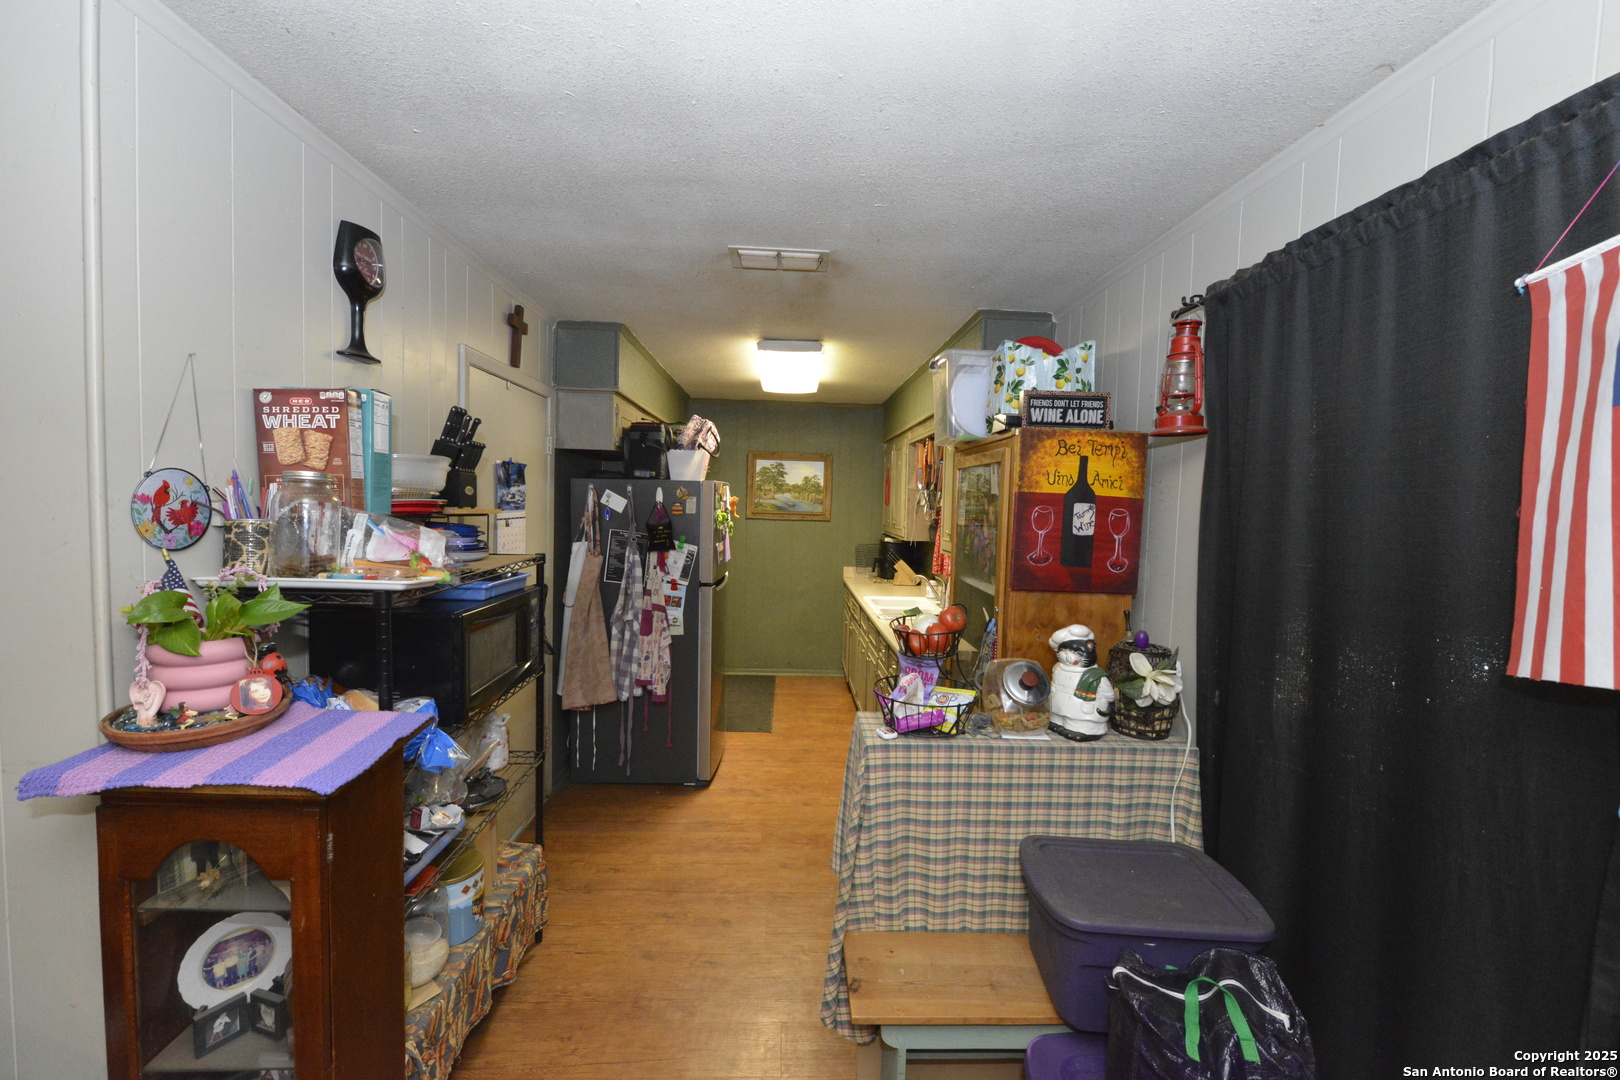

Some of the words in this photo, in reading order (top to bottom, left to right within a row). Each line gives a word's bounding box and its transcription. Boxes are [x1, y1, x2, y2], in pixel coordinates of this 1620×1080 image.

[1030, 399, 1053, 407] FRIENDS
[1053, 399, 1069, 407] DON'T
[1081, 400, 1104, 408] FRIENDS
[262, 414, 340, 429] WHEAT
[1030, 408, 1063, 423] WINE
[1065, 409, 1104, 424] ALONE
[1055, 439, 1081, 456] Bei
[1087, 439, 1126, 467] Tempi
[1090, 470, 1123, 490] Amici
